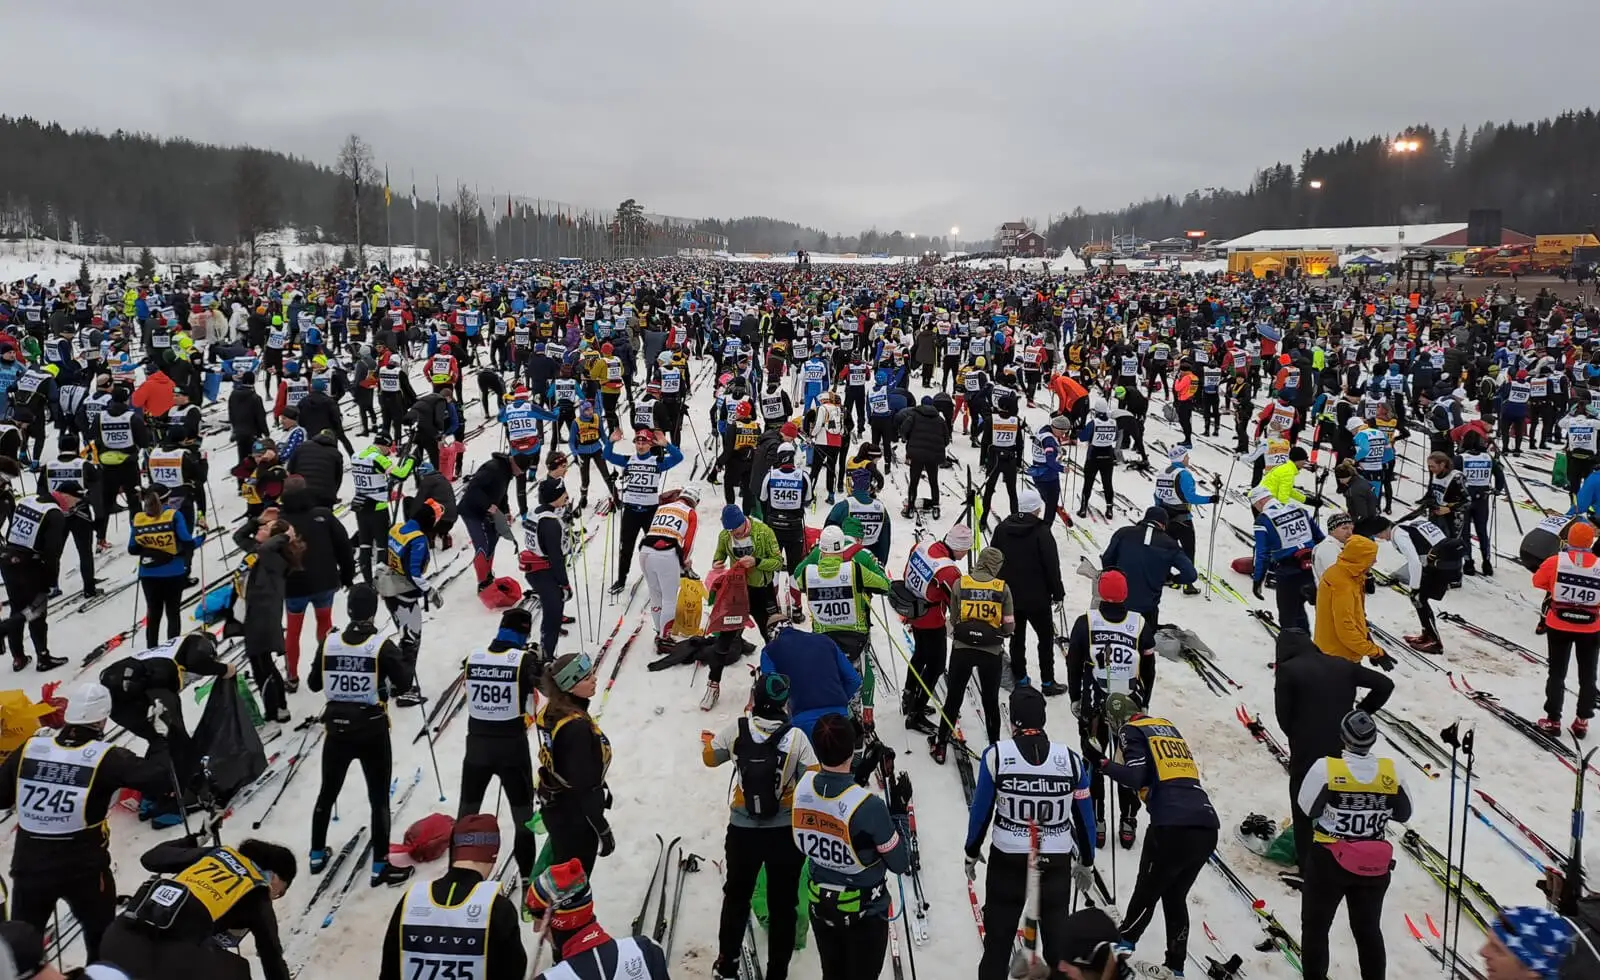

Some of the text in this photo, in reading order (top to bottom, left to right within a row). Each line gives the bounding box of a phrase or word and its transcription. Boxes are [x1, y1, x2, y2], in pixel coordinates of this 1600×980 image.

[510, 419, 531, 430] 2916
[105, 433, 128, 441] 7855
[996, 432, 1014, 440] 7731
[1096, 433, 1113, 441] 7042
[154, 468, 177, 479] 7134
[628, 473, 655, 485] 2251
[773, 489, 798, 501] 3445
[12, 516, 33, 536] 7423
[653, 514, 683, 531] 2024
[1281, 519, 1307, 539] 7649
[909, 566, 923, 593] 7281
[818, 588, 844, 600] IBM
[970, 589, 994, 600] IBM
[1561, 586, 1596, 602] 7148
[814, 602, 851, 616] 7400
[966, 603, 998, 618] 7194
[1095, 633, 1133, 647] stadium
[336, 656, 366, 671] IBM
[1096, 647, 1133, 665] 782
[470, 667, 513, 679] stadium
[330, 675, 370, 692] 7862
[472, 684, 512, 704] 7684
[36, 761, 80, 785] IBM
[1002, 777, 1071, 793] stadium
[22, 784, 77, 814] 7245
[1339, 793, 1386, 810] IBM
[1006, 797, 1064, 822] 1001
[797, 832, 856, 866] 12666
[158, 887, 178, 902] 103
[409, 934, 476, 945] VOLVO
[409, 957, 475, 980] 7735
